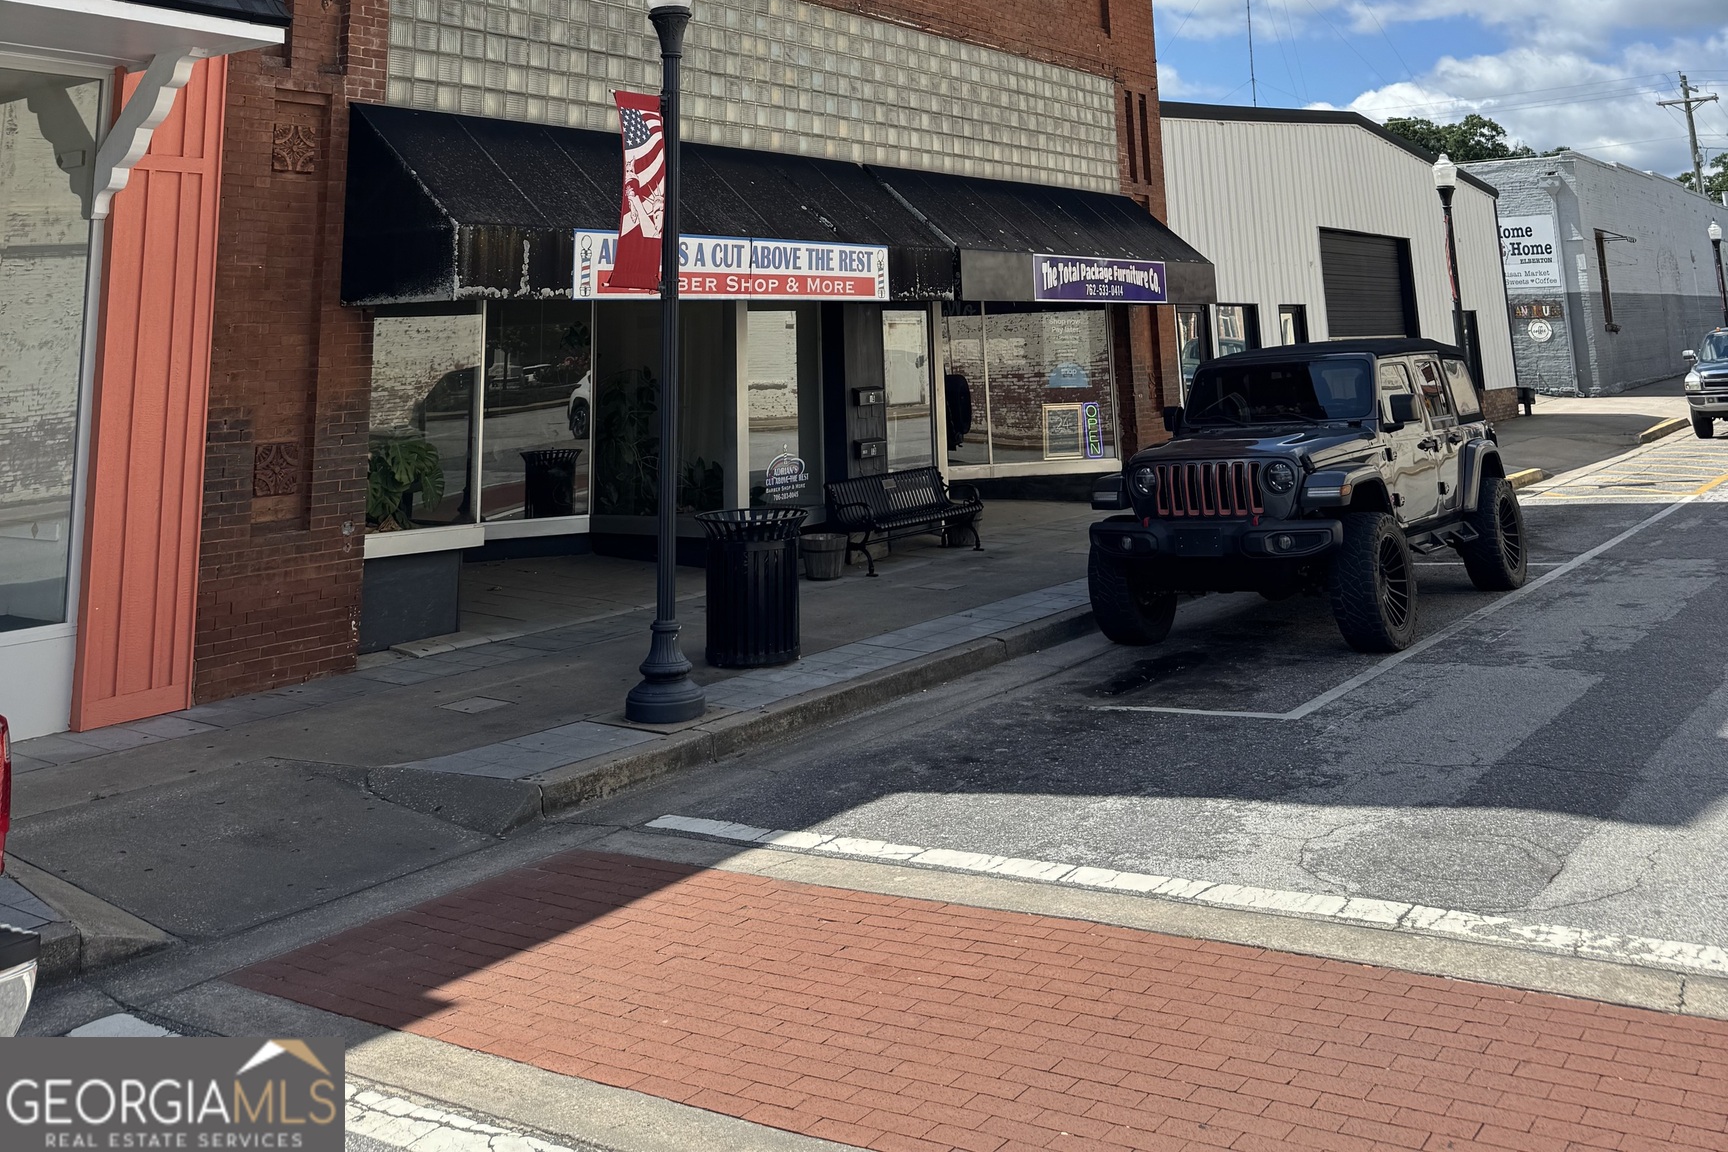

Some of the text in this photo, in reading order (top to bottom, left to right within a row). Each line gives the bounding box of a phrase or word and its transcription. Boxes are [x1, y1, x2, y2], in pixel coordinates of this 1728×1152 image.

[694, 243, 706, 267] A
[711, 243, 745, 268] CUT
[749, 245, 802, 270] ABOVE
[806, 248, 835, 271] THE
[838, 250, 874, 273] REST
[1509, 241, 1553, 256] Home
[726, 275, 779, 293] SHOP
[786, 277, 799, 293] &
[807, 278, 855, 293] MORE
[1042, 260, 1058, 290] The
[1058, 261, 1080, 284] Total
[1080, 262, 1113, 283] Package
[1113, 264, 1149, 288] Furniture
[1086, 283, 1124, 296] 762-533-0414
[1086, 405, 1101, 454] OPEN
